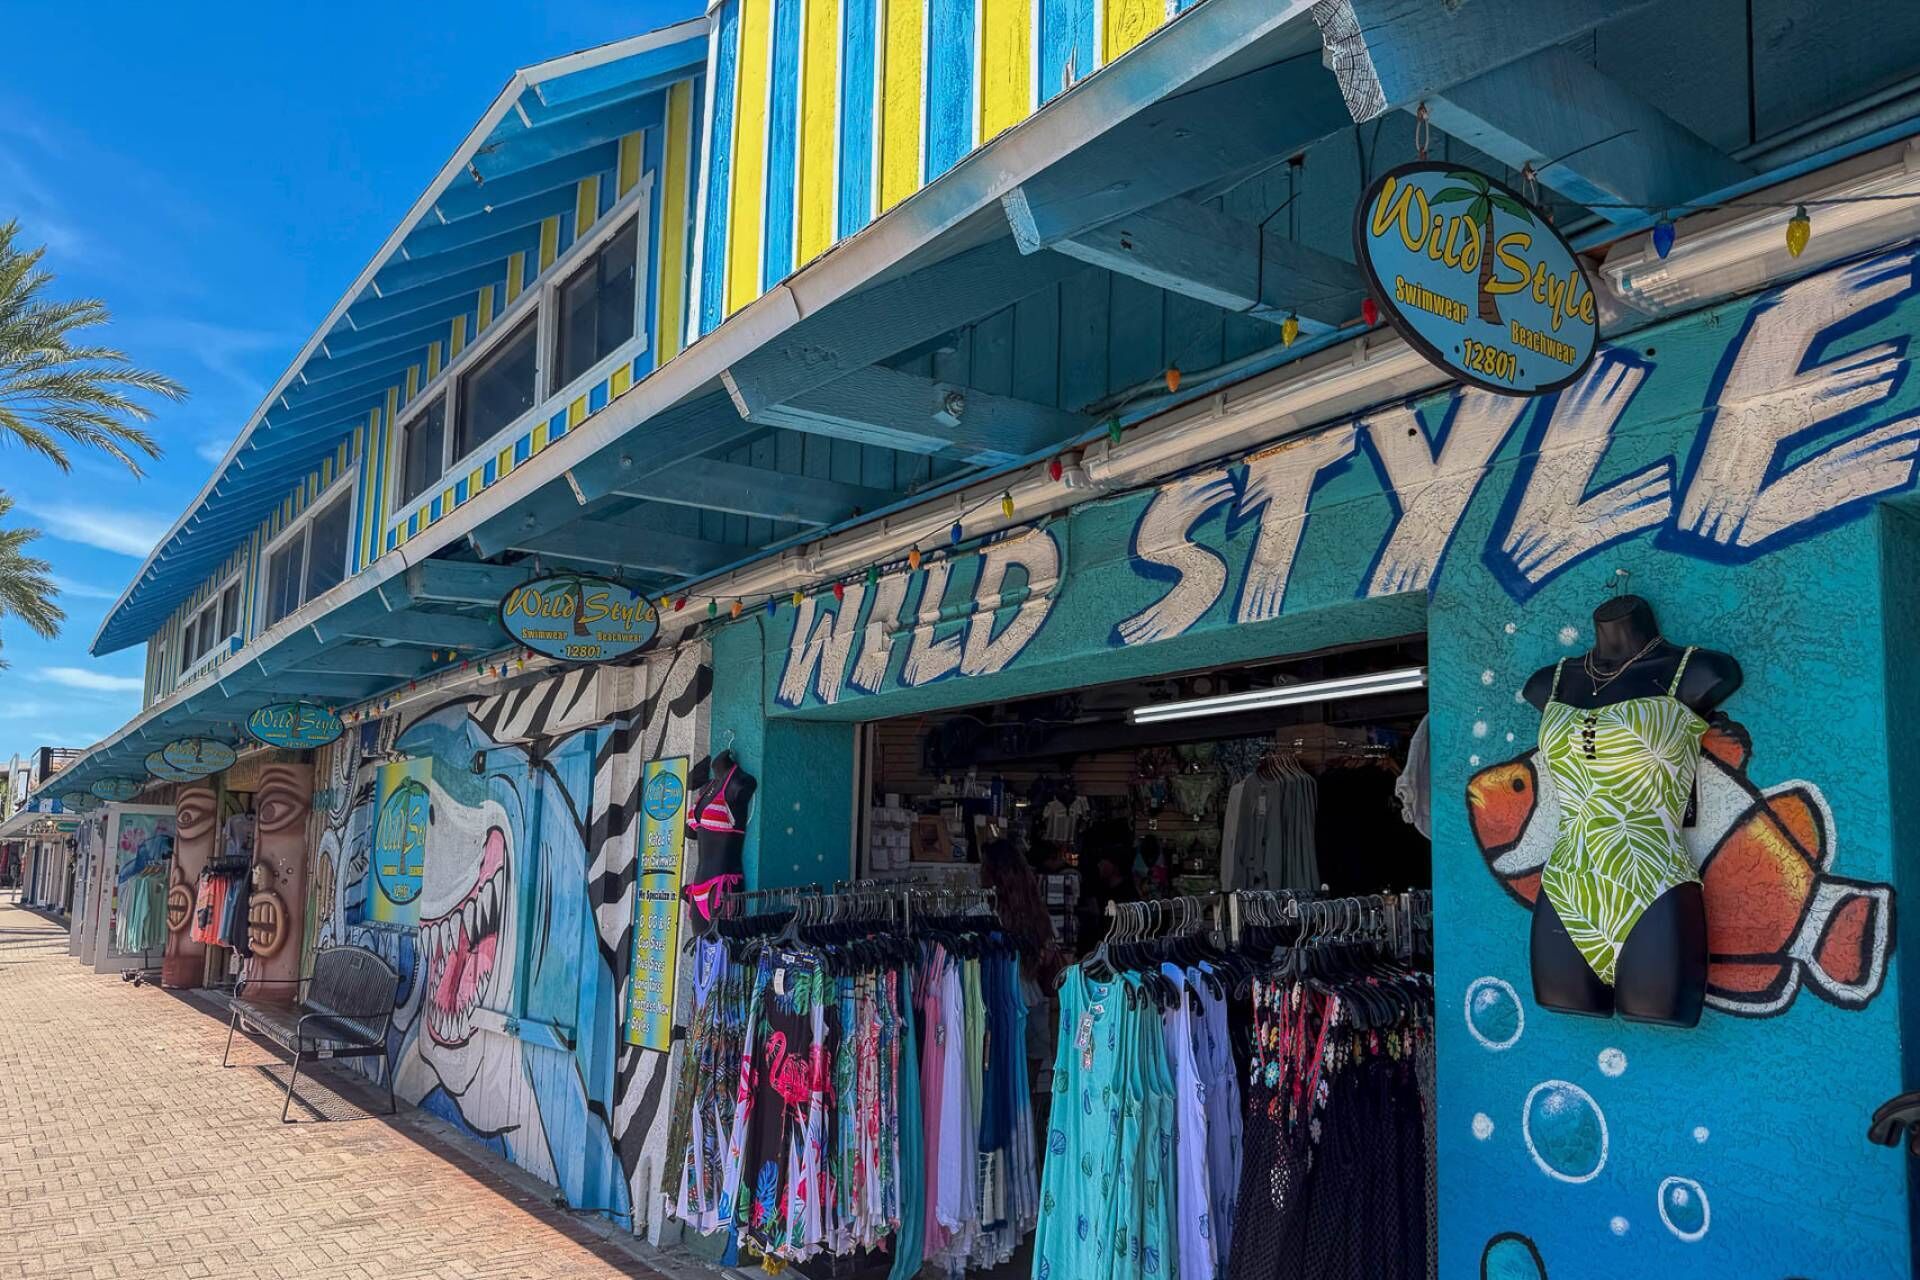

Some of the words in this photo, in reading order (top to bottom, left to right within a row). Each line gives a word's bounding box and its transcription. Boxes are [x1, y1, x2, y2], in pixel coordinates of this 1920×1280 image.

[1371, 175, 1481, 273] Wild
[1483, 232, 1595, 333] Style
[1395, 275, 1469, 325] Swimwear
[1511, 320, 1577, 367] Beachwear
[1463, 338, 1517, 385] 12801
[775, 523, 1061, 706] WILD
[1109, 240, 1920, 650] STYLE
[505, 588, 576, 618] Wild
[577, 592, 656, 631] Style
[521, 627, 568, 641] Swimwear
[595, 630, 641, 643] Beachwear
[565, 645, 601, 658] 12801
[250, 709, 293, 728] Wild
